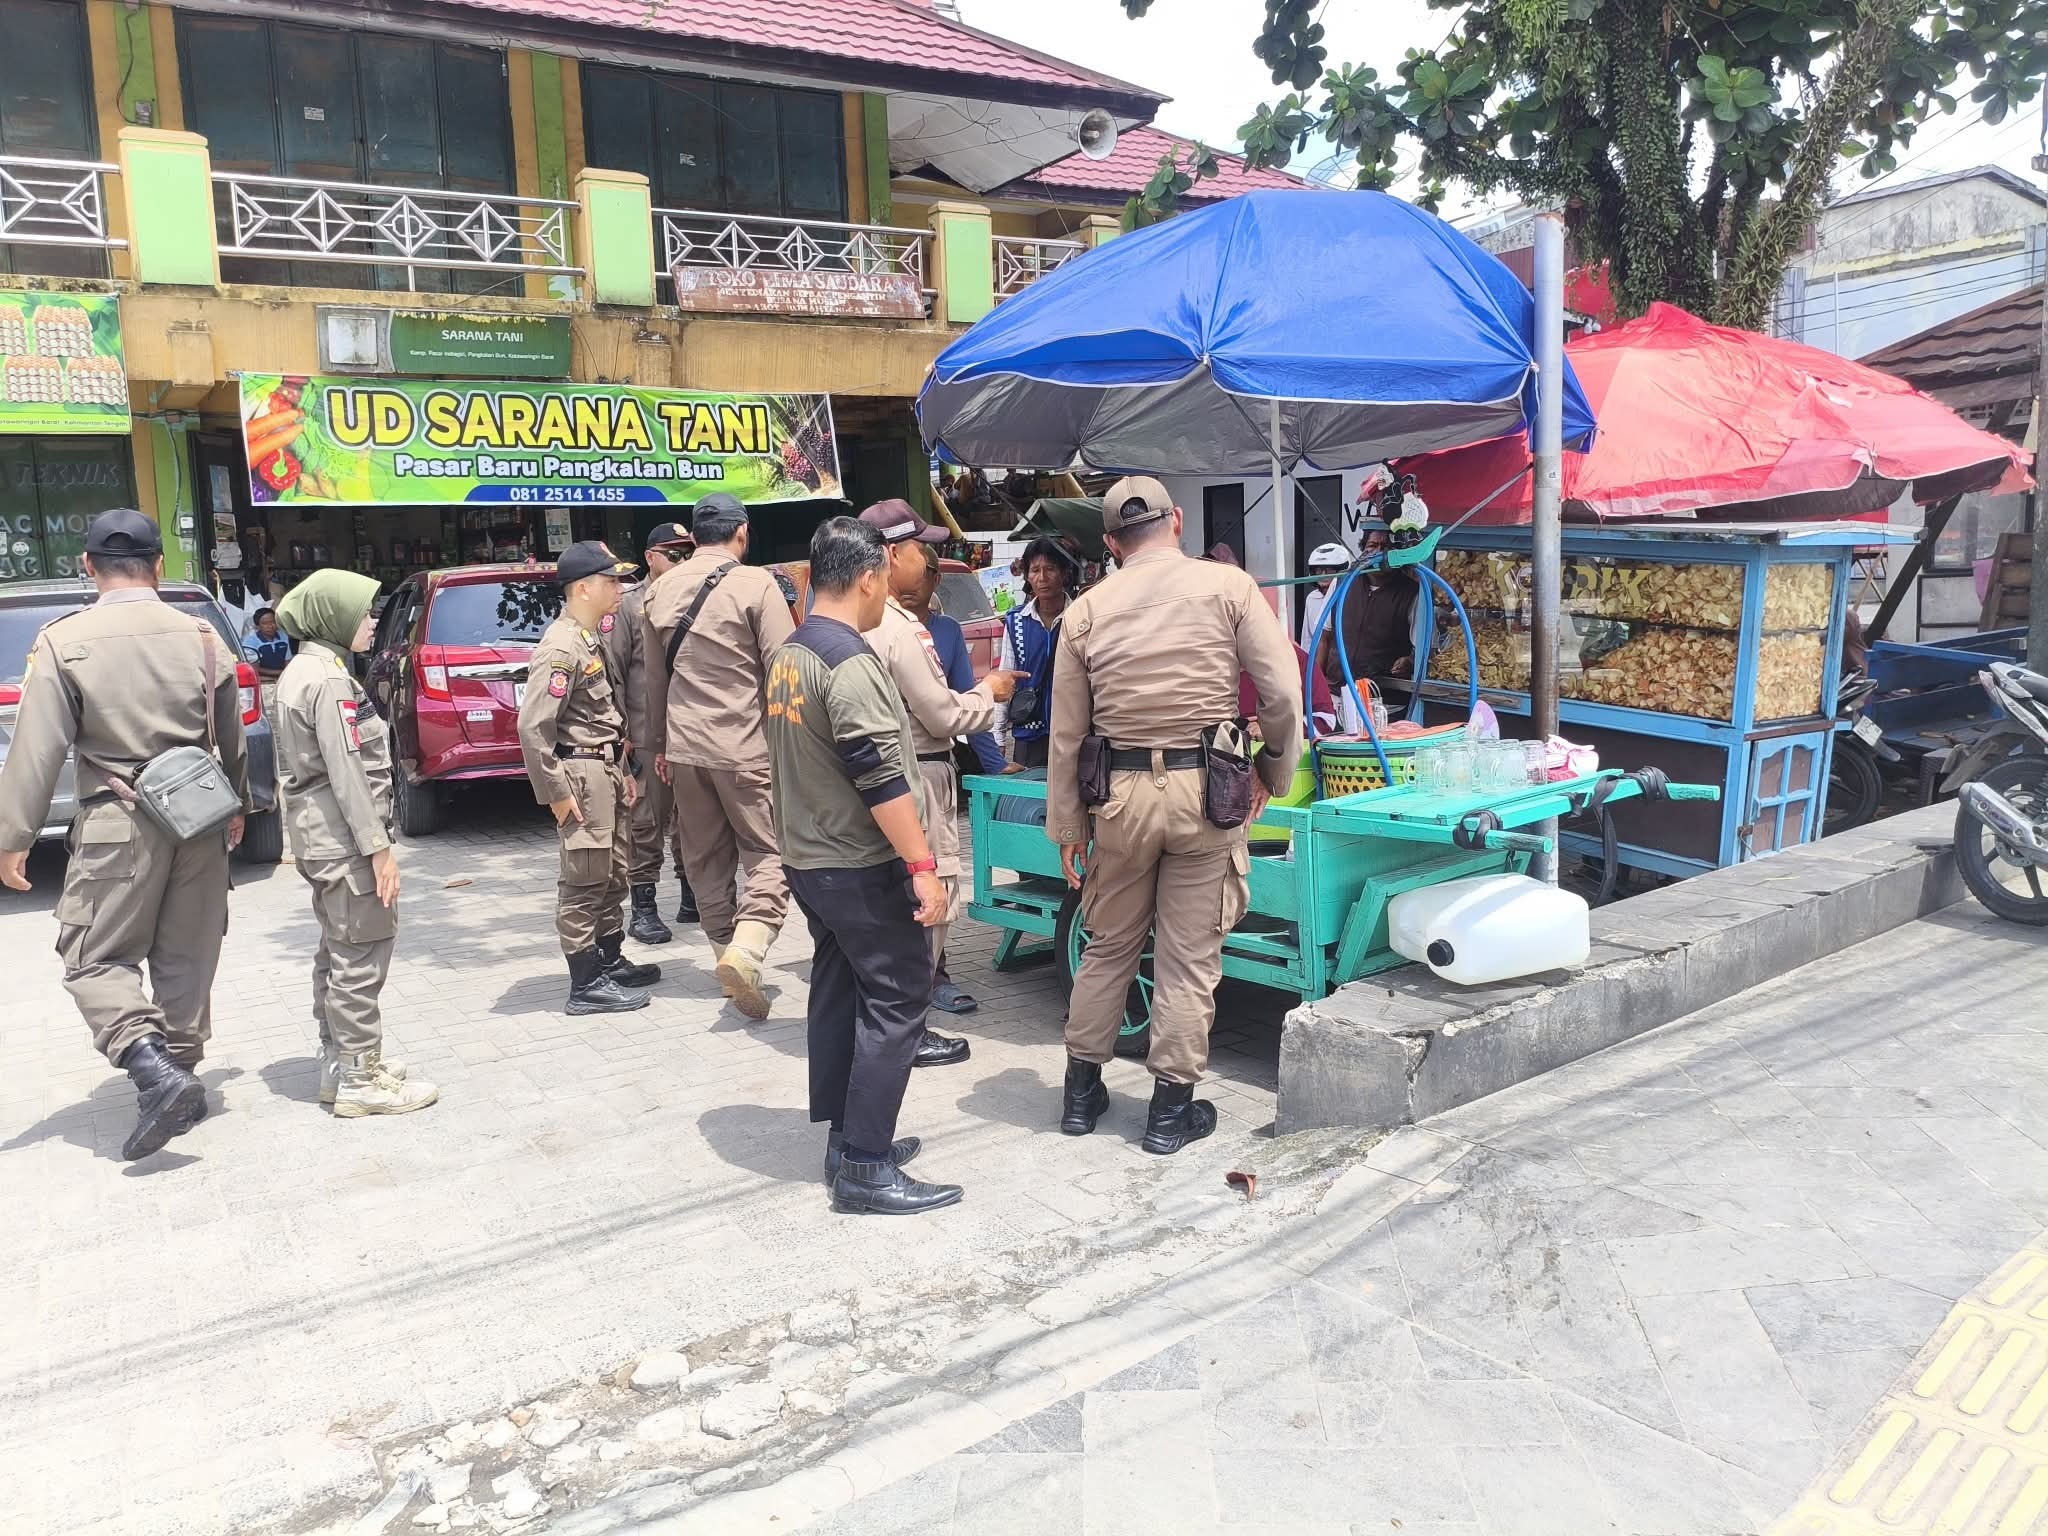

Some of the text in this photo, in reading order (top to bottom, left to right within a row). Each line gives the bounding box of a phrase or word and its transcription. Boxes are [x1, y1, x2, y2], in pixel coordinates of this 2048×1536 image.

[706, 270, 757, 287] TOKO
[814, 273, 894, 293] SAUDARA
[441, 330, 524, 342] SARANA TANI
[327, 389, 770, 453] UD SARANA TANI
[394, 454, 724, 482] Pasar Baru Pangkalan Bun
[510, 488, 625, 501] 081 2514 1455
